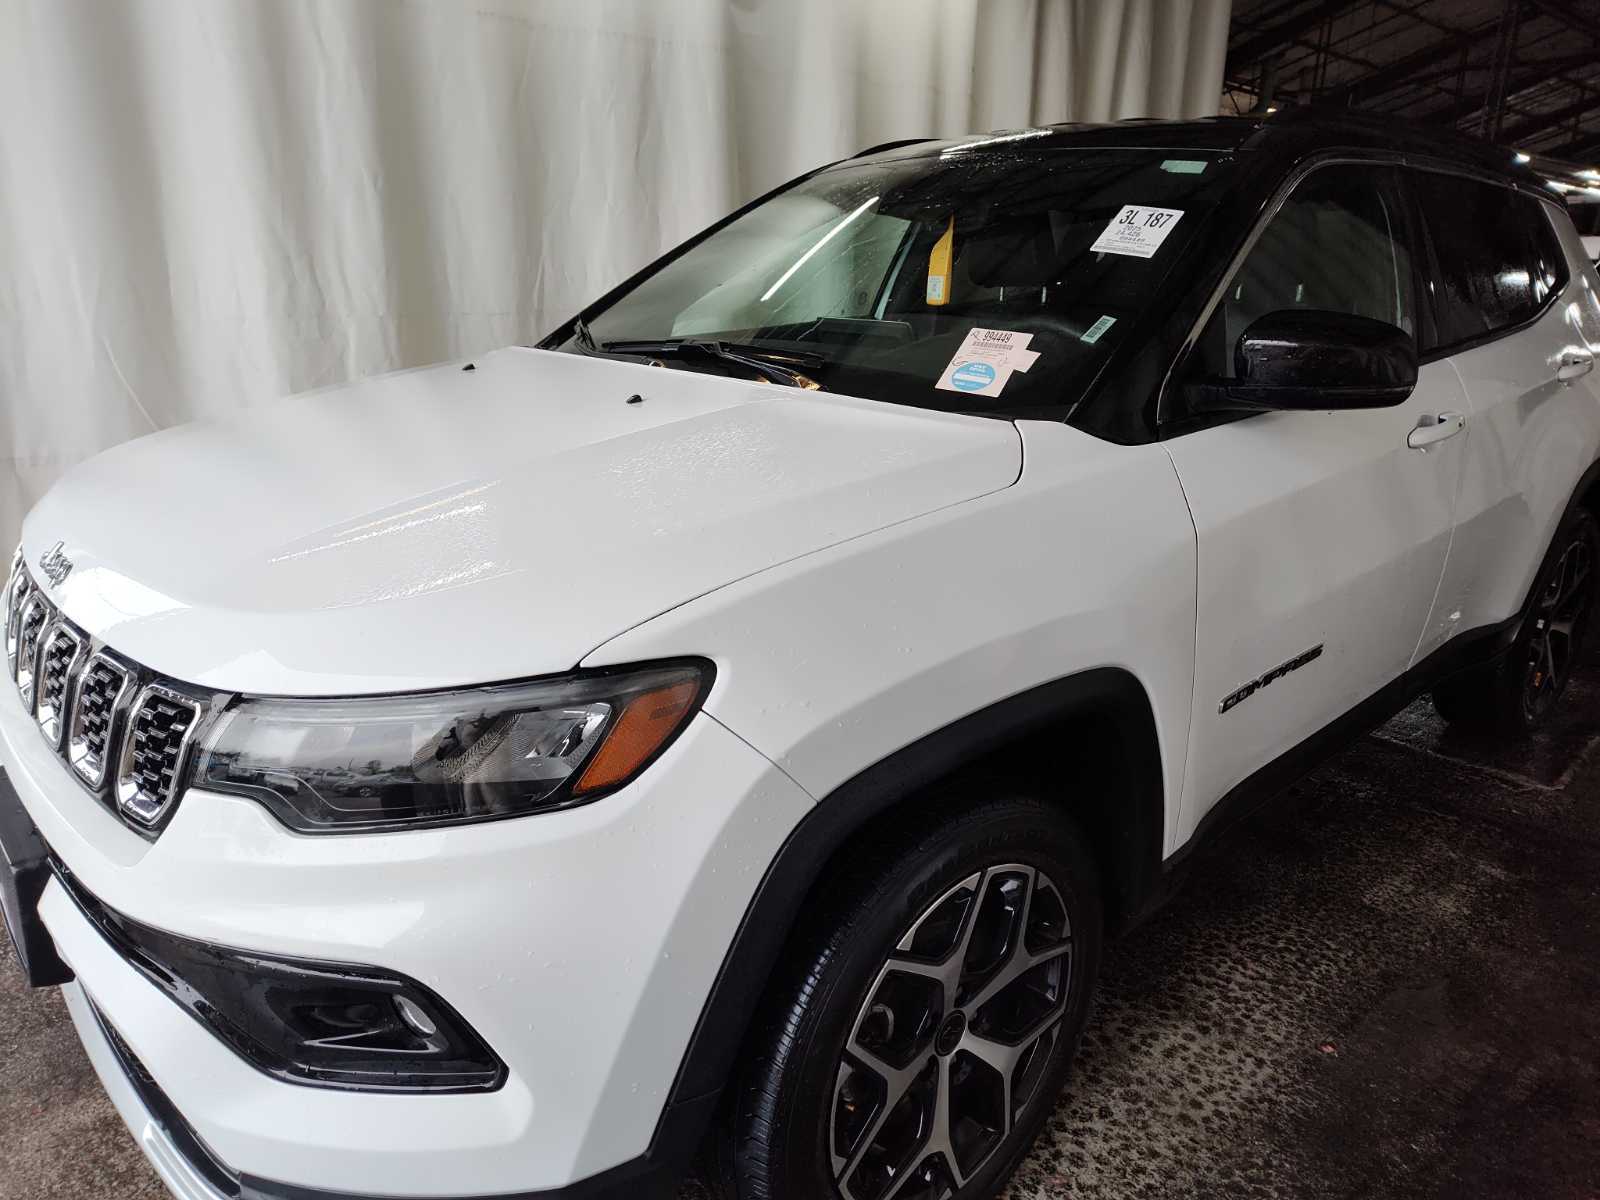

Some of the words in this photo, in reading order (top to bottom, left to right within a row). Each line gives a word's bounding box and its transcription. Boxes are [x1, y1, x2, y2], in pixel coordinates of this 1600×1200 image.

[1119, 210, 1140, 224] 3L
[1143, 213, 1174, 228] 187
[981, 330, 1013, 344] 994449
